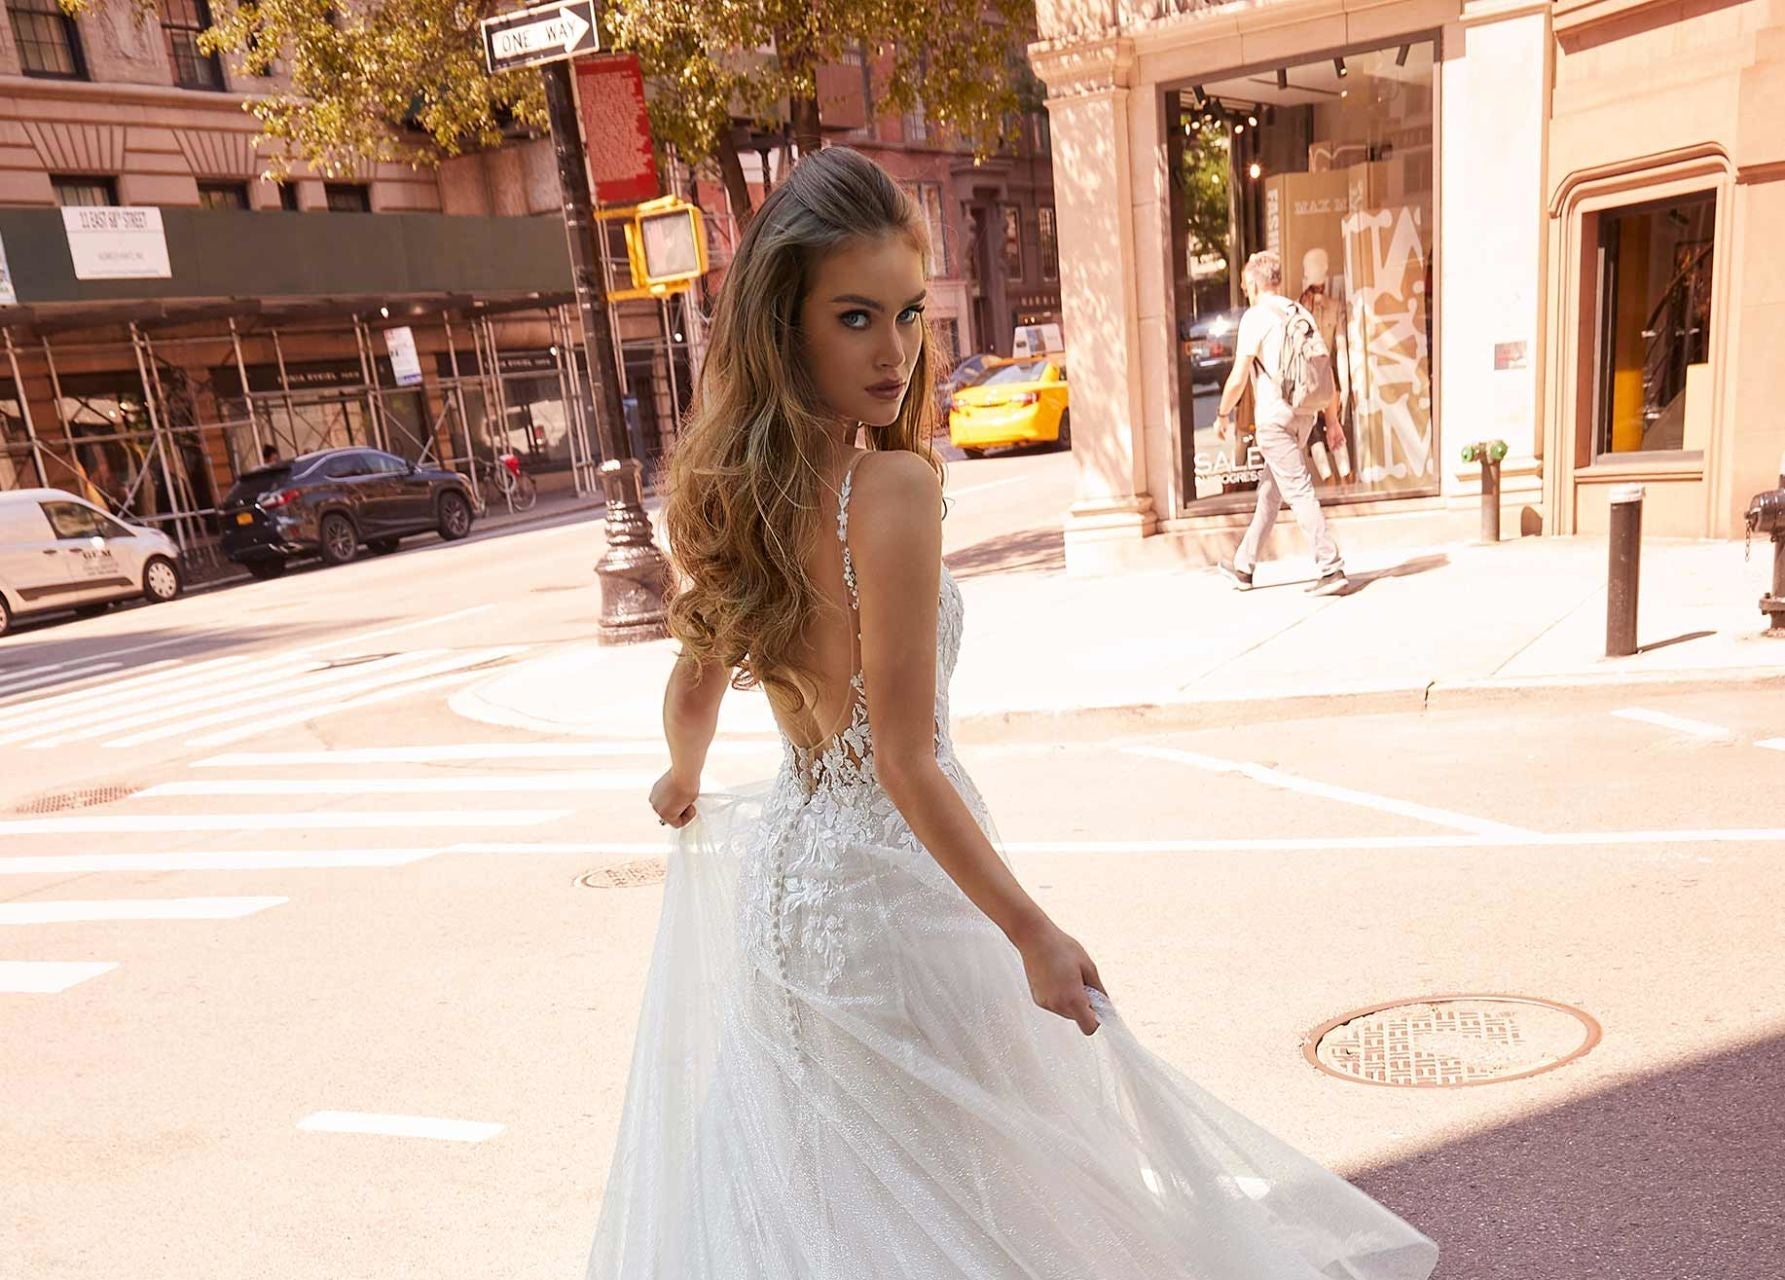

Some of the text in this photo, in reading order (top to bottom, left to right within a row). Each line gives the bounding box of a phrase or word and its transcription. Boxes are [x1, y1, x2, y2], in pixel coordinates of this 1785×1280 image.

[502, 20, 576, 53] ONE WAY
[1194, 446, 1264, 476] SALE
